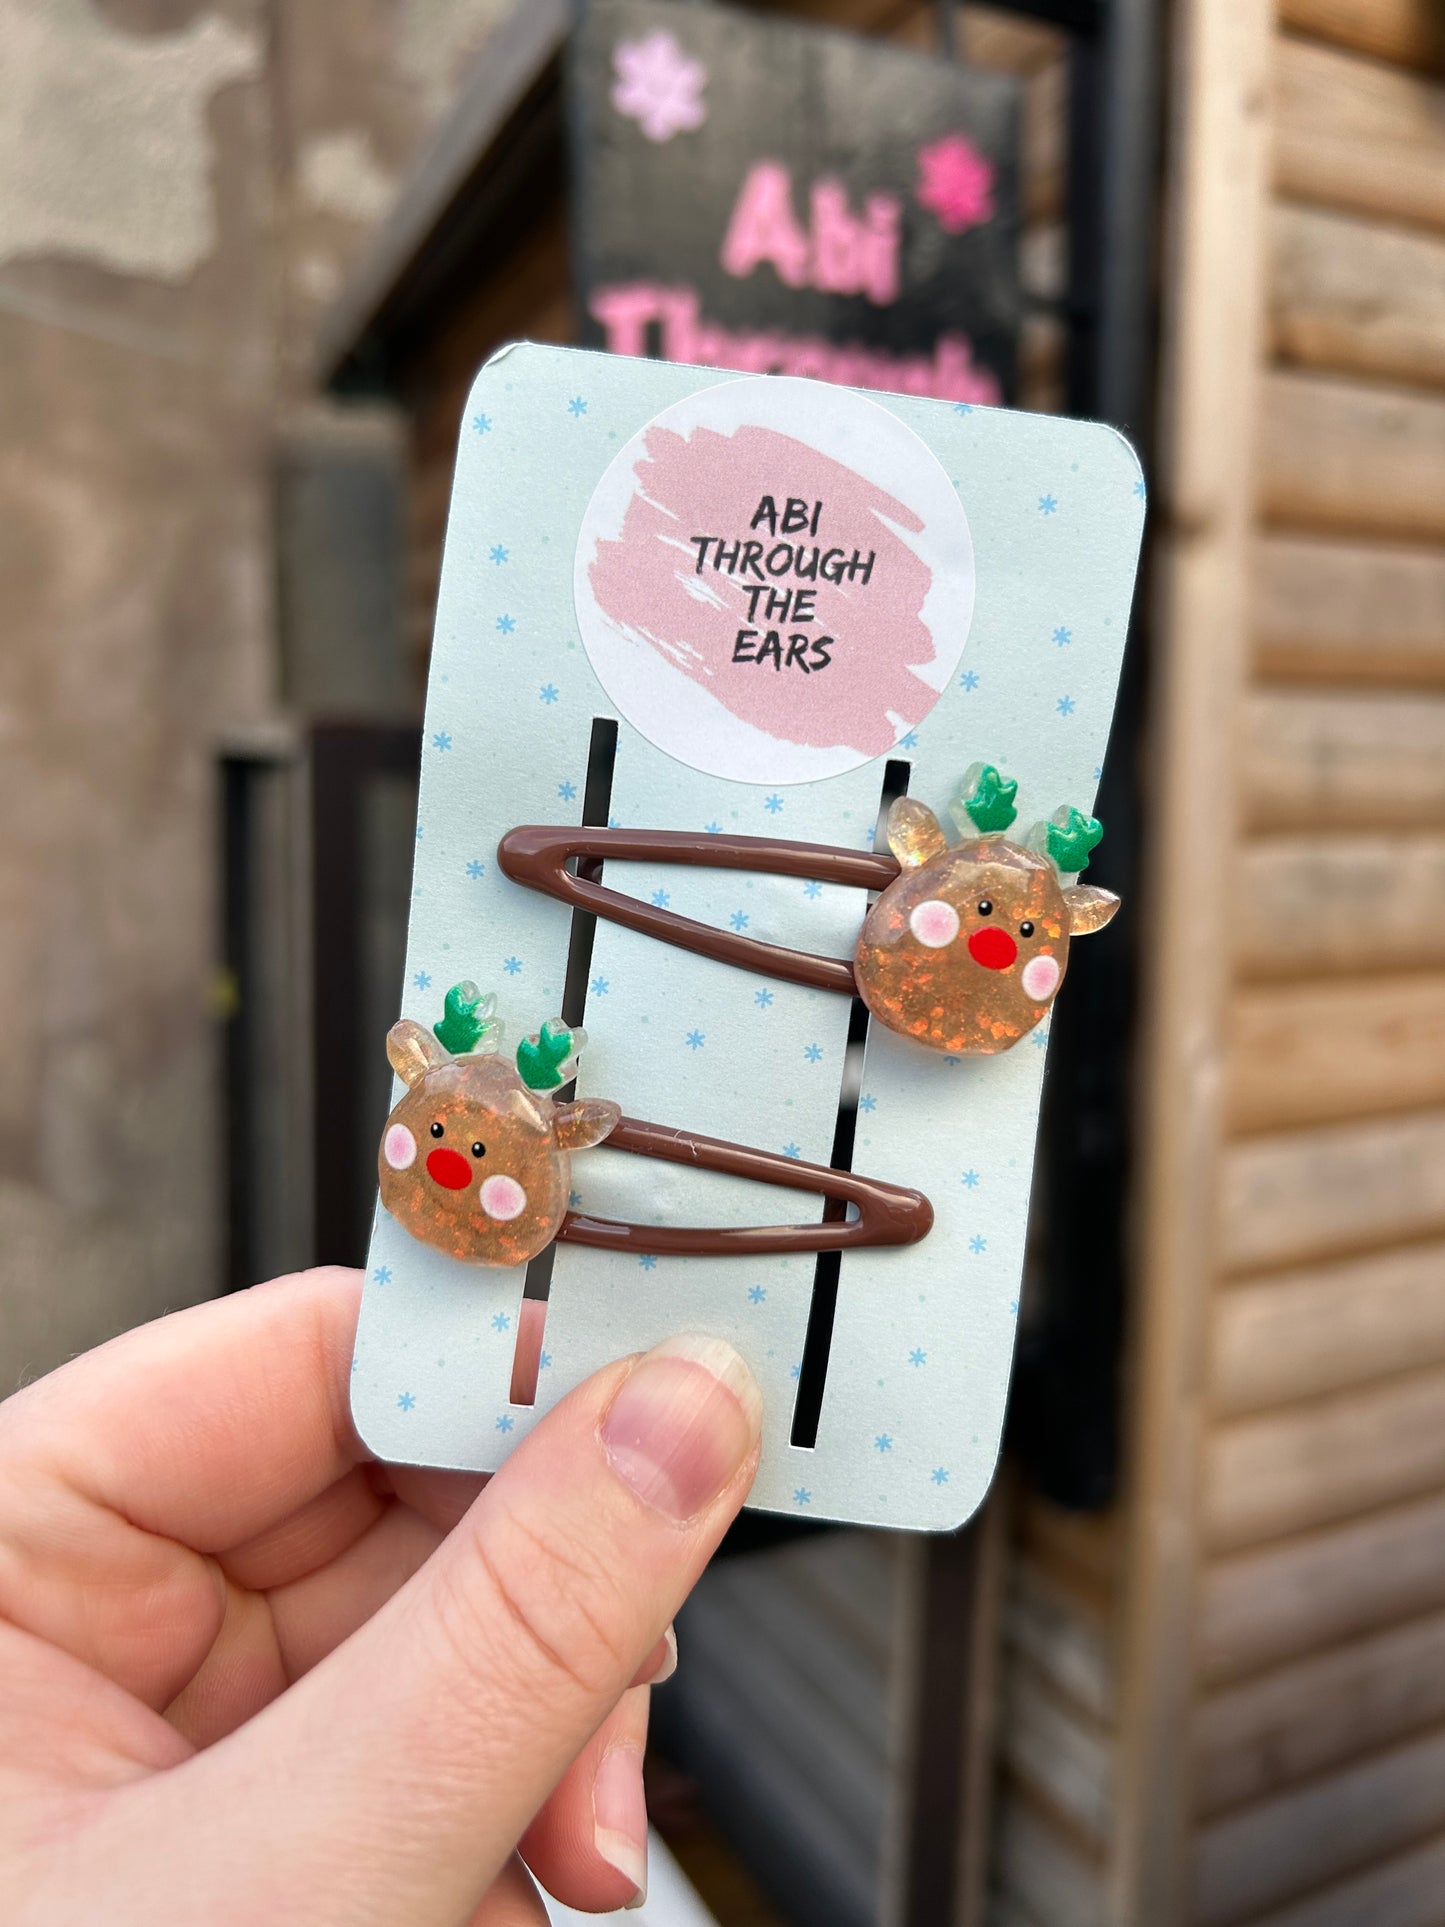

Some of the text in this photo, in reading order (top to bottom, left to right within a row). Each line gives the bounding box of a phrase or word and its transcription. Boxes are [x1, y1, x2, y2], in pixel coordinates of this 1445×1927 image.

[722, 161, 900, 304] Abi
[750, 495, 823, 537] ABI
[690, 536, 876, 586] THROUGH
[742, 585, 818, 624] THE
[731, 629, 834, 674] EARS
